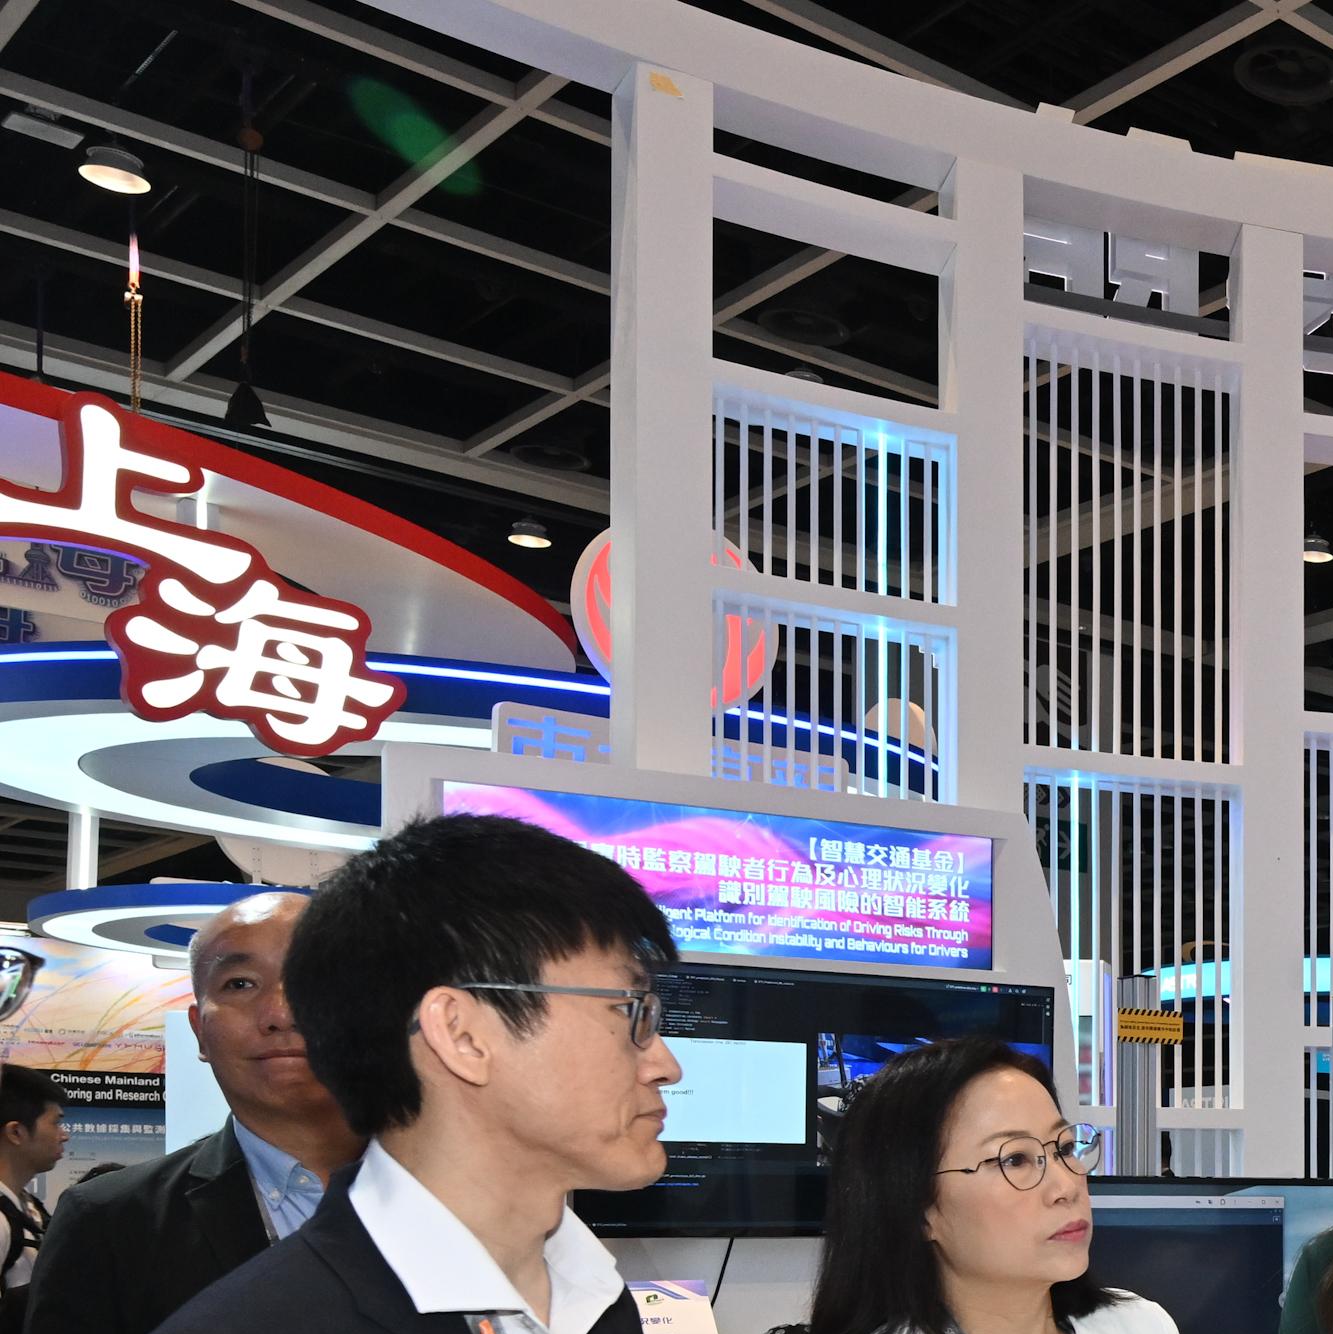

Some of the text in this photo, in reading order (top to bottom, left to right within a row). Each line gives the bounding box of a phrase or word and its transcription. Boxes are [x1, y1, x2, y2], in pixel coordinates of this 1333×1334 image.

[0, 403, 395, 746] 上海
[576, 840, 970, 899] 實時監察駕駛者行為及心理狀況變化
[694, 908, 745, 925] Platform
[748, 911, 765, 925] for
[767, 912, 838, 932] Identification
[840, 919, 851, 932] of
[853, 920, 892, 939] Driving
[894, 924, 923, 938] Risks
[925, 926, 969, 944] Through
[713, 928, 765, 944] Condition
[825, 937, 846, 951] and
[847, 938, 909, 954] Behaviours
[911, 940, 927, 955] for
[928, 943, 969, 959] Drivers
[50, 1072, 161, 1087] Chinese Mainland
[95, 1089, 113, 1101] and
[115, 1089, 161, 1102] Research
